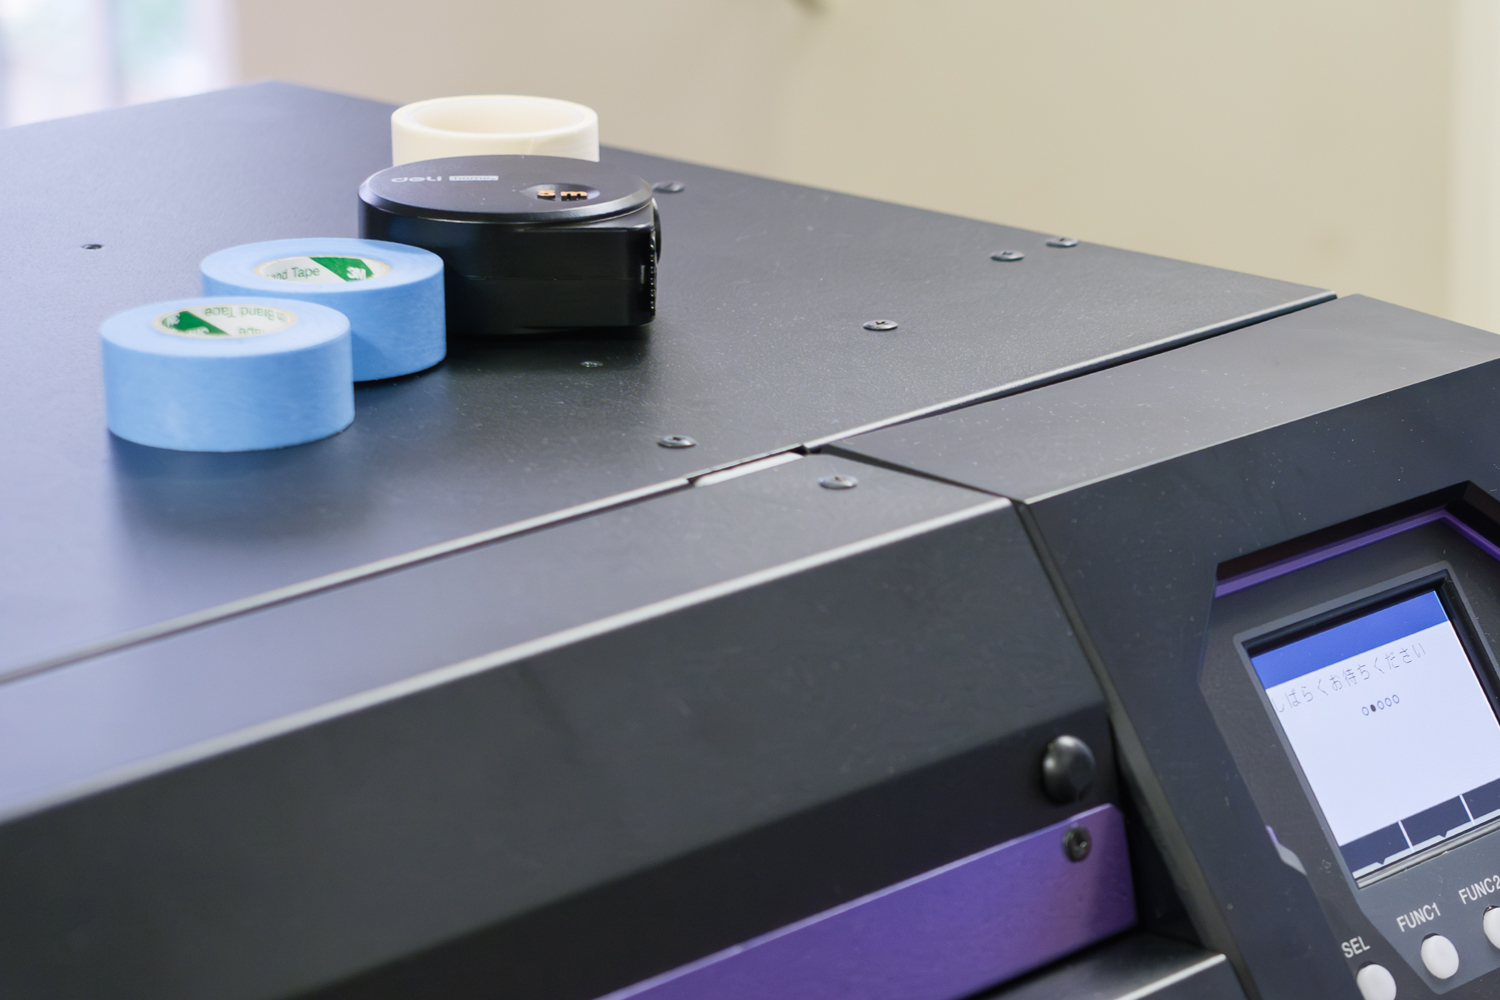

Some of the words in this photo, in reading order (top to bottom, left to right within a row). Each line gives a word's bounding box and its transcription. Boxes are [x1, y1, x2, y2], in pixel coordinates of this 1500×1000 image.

[291, 266, 320, 279] Tape
[346, 266, 367, 281] 3M
[1273, 643, 1426, 713] しばらくお待ちください
[1396, 902, 1442, 933] FUNC1
[1341, 936, 1371, 958] SEL
